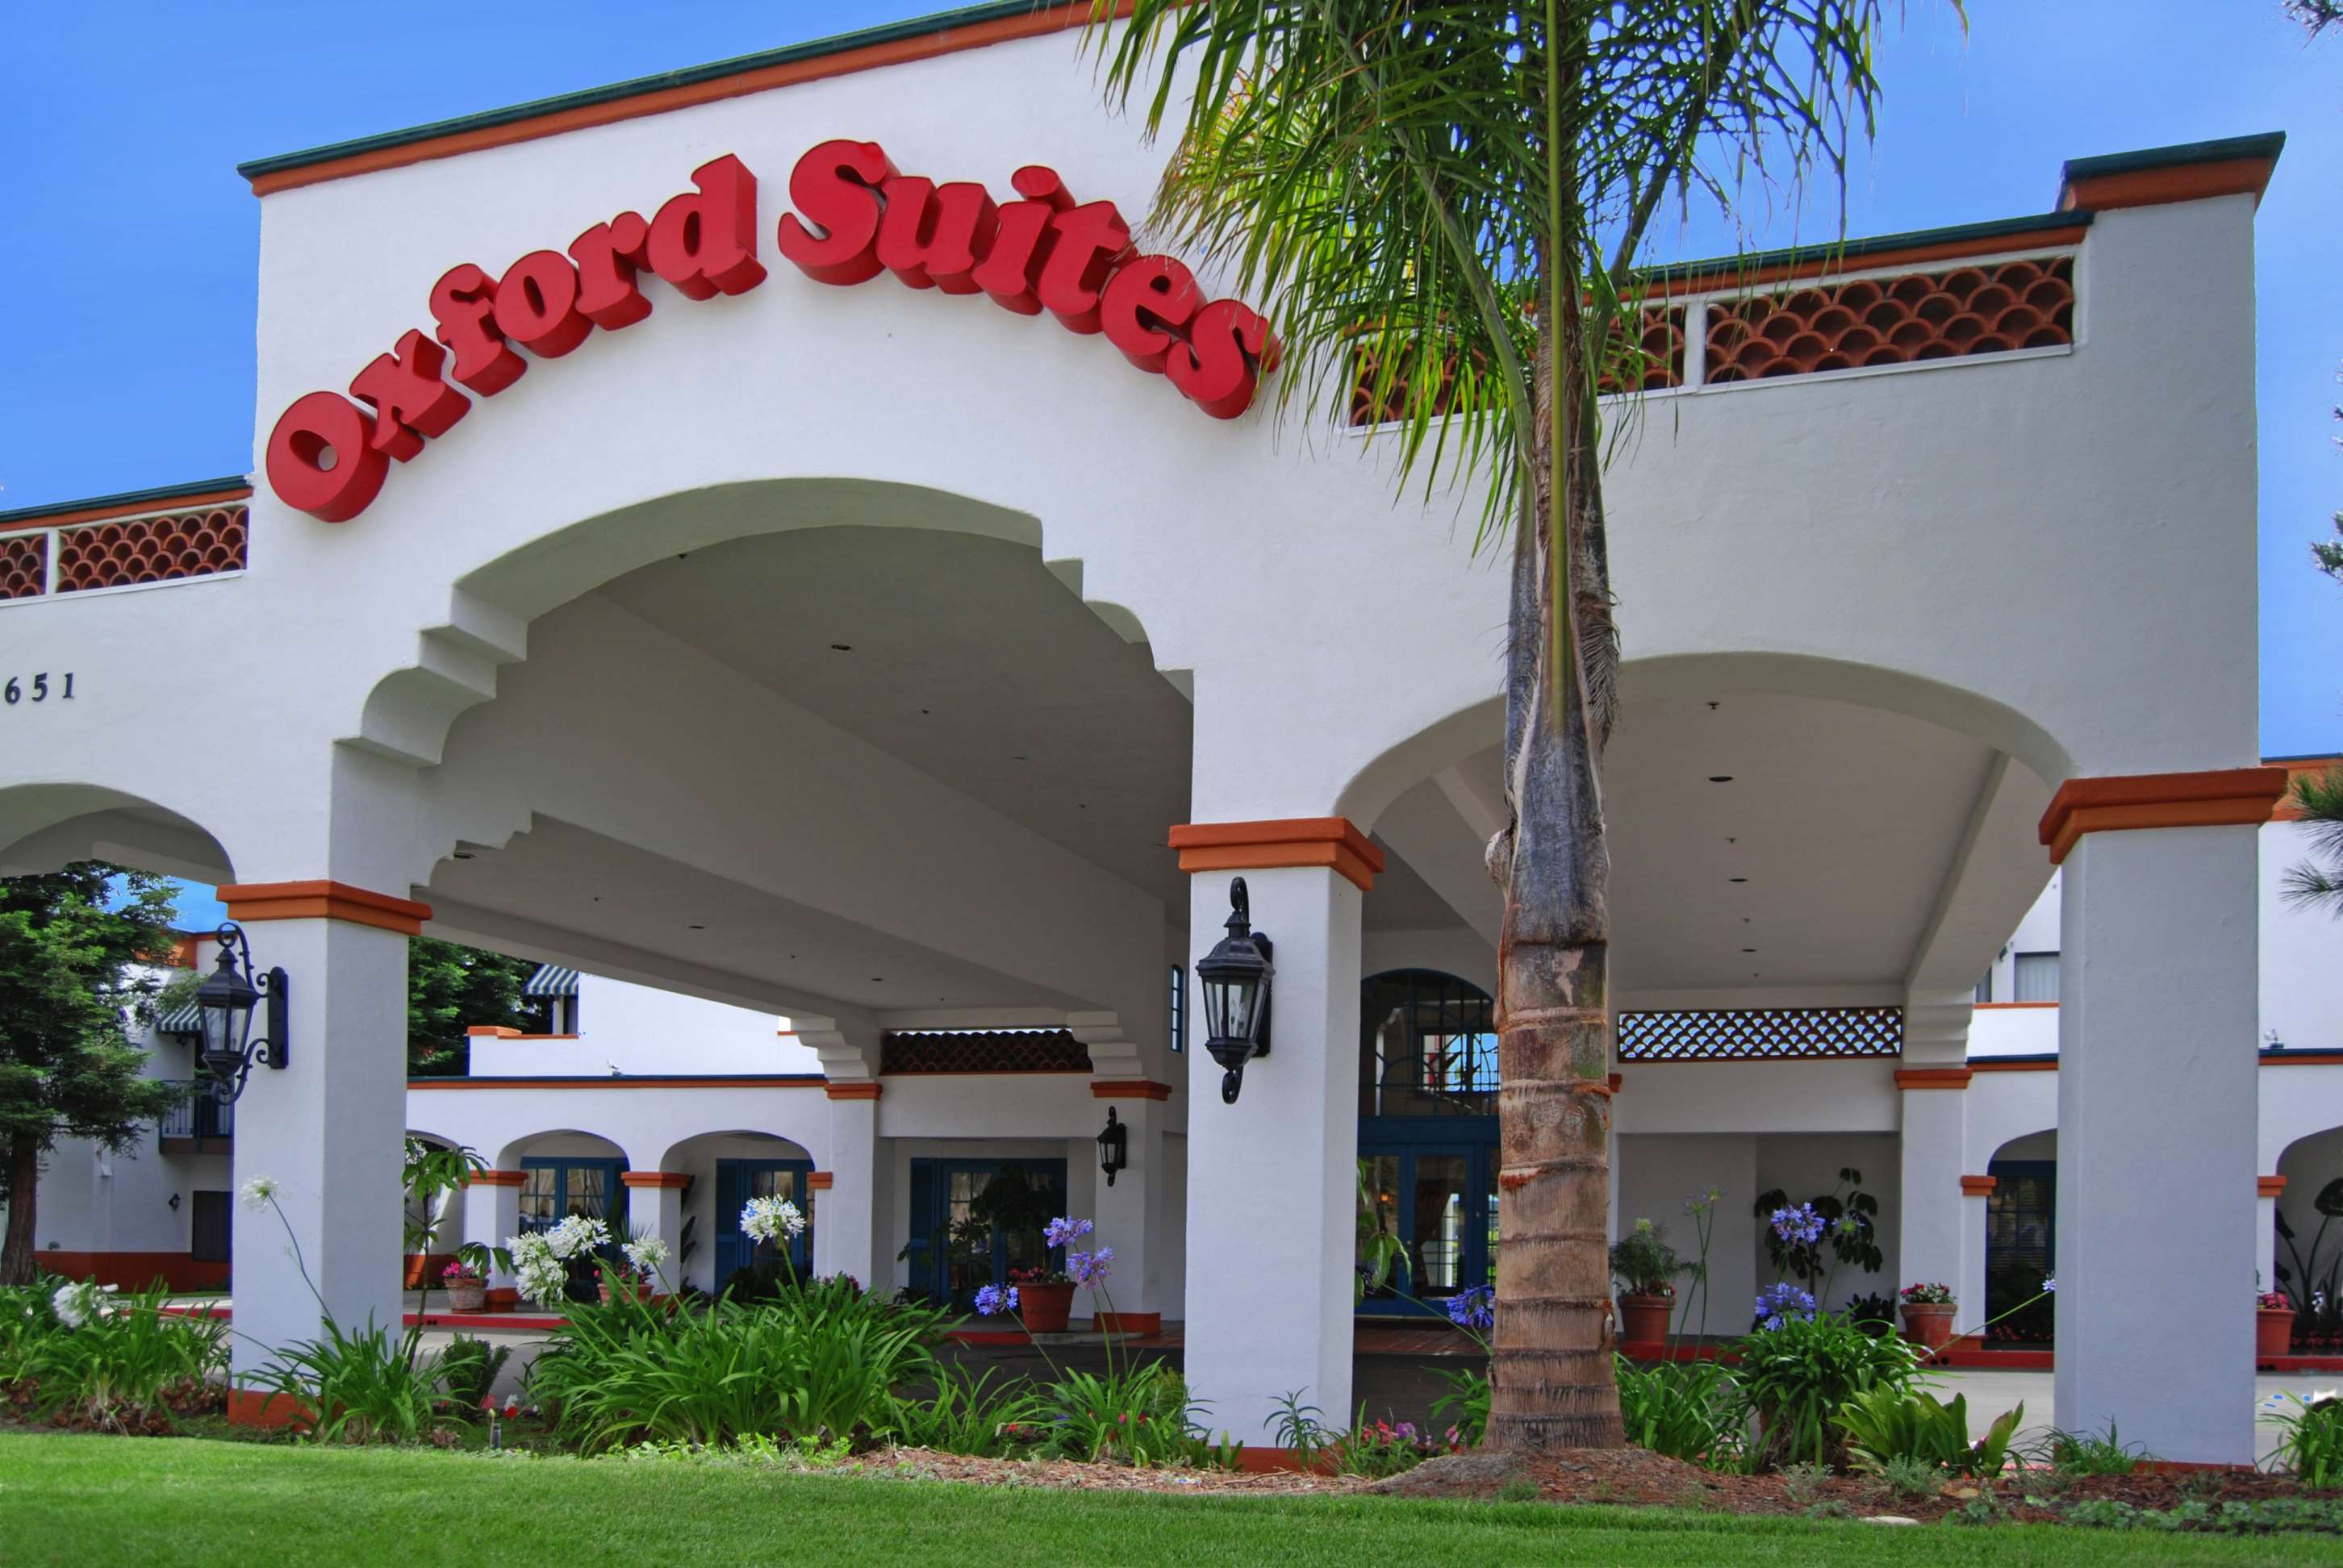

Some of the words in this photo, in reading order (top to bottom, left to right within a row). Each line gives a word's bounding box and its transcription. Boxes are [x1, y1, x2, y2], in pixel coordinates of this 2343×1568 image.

[266, 153, 767, 523] Oxford
[777, 139, 1280, 419] Suites
[5, 672, 75, 705] 651
